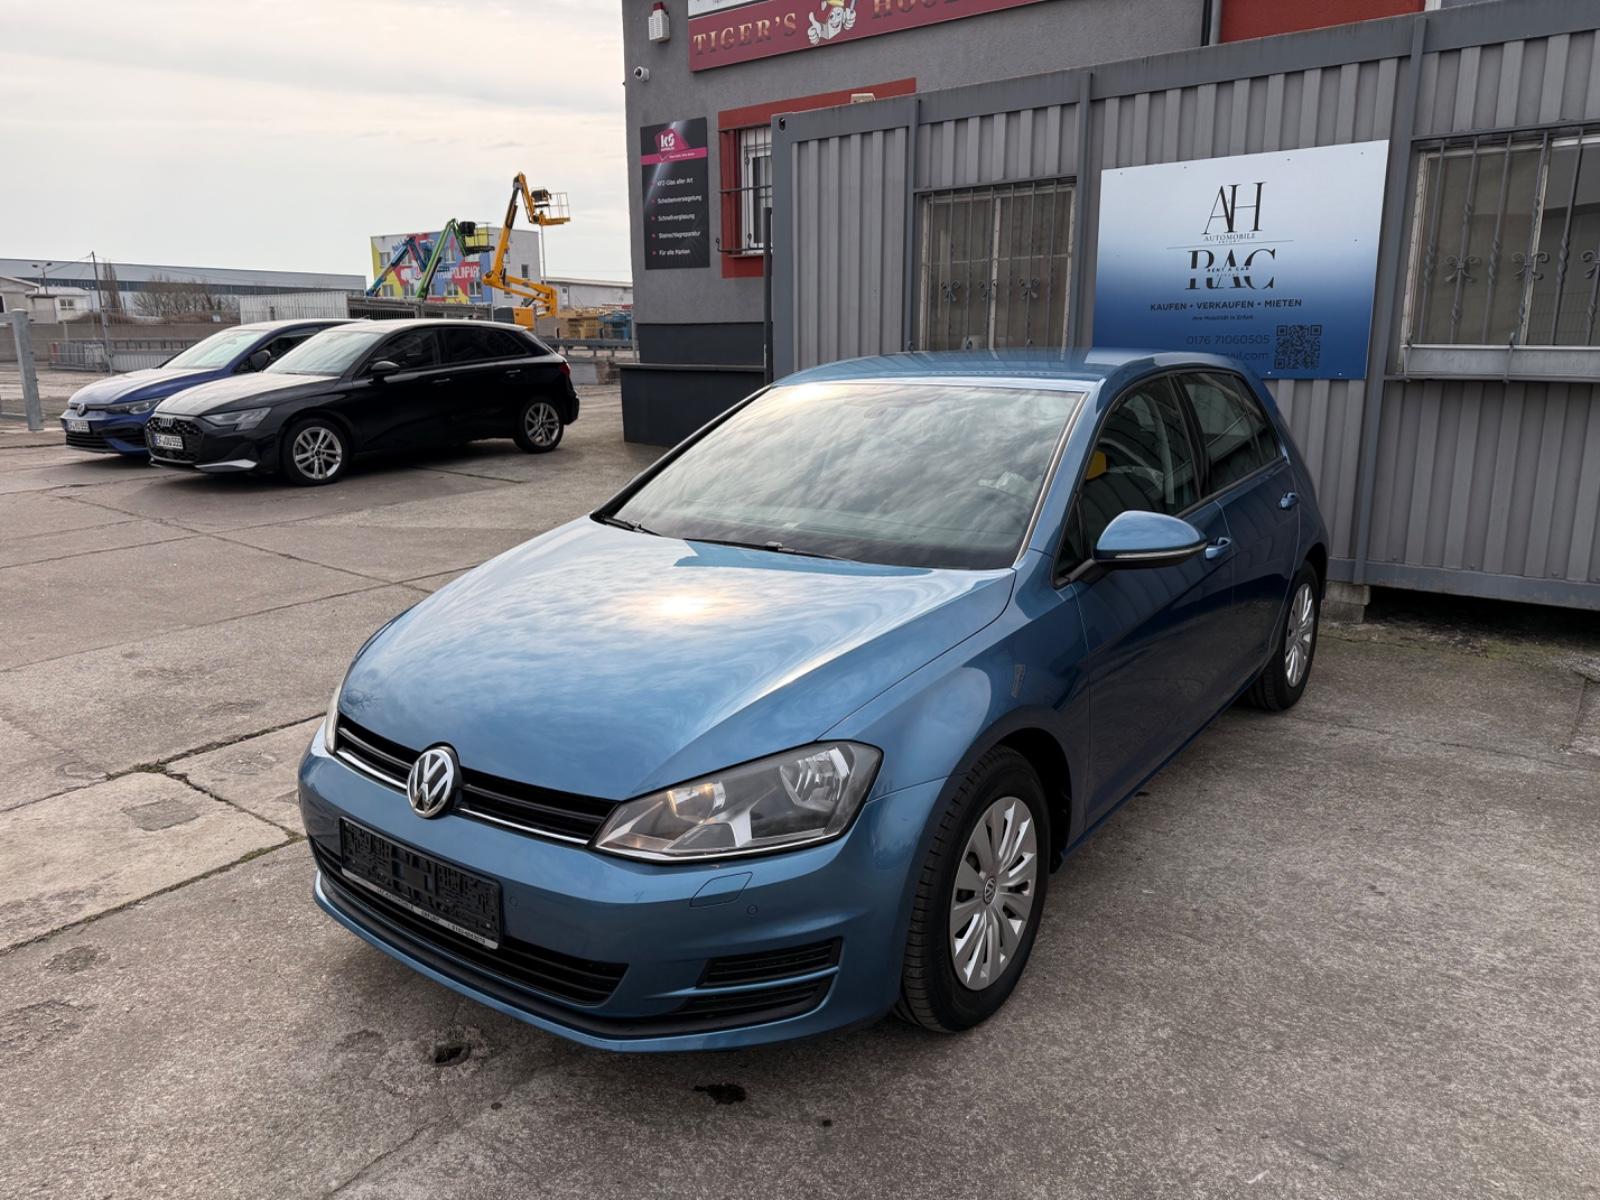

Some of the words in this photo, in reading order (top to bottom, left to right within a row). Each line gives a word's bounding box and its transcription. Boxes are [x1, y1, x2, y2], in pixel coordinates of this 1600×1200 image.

[693, 13, 797, 55] TIGER'S
[1201, 181, 1267, 235] AH
[1203, 233, 1256, 242] AUTOMOBILE
[1184, 248, 1276, 290] RAC
[1150, 302, 1188, 312] KAUFEN
[1196, 300, 1255, 310] VERKAUFEN
[1264, 298, 1303, 308] MIETEN
[1186, 336, 1211, 345] 0176
[1215, 334, 1271, 345] 71060505
